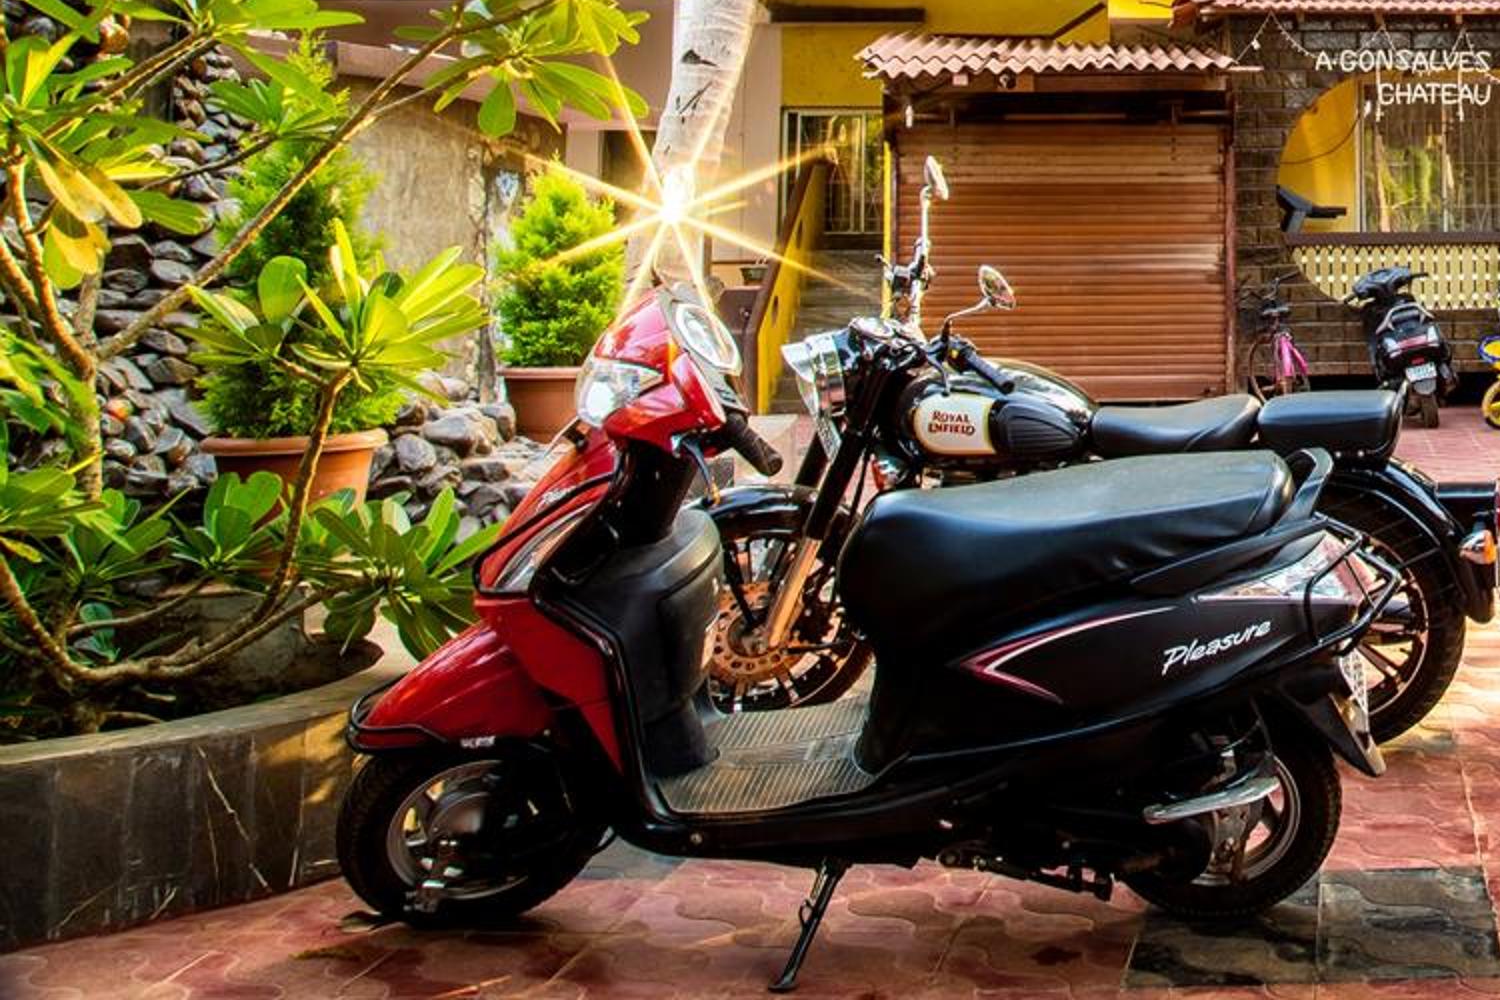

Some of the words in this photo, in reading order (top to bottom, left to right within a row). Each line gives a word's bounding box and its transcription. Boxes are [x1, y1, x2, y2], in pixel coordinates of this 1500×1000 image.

[1378, 83, 1492, 105] CHATEAU
[931, 410, 971, 423] ROYAL
[927, 422, 976, 436] ENFIELD
[1161, 619, 1272, 676] Pleasure
